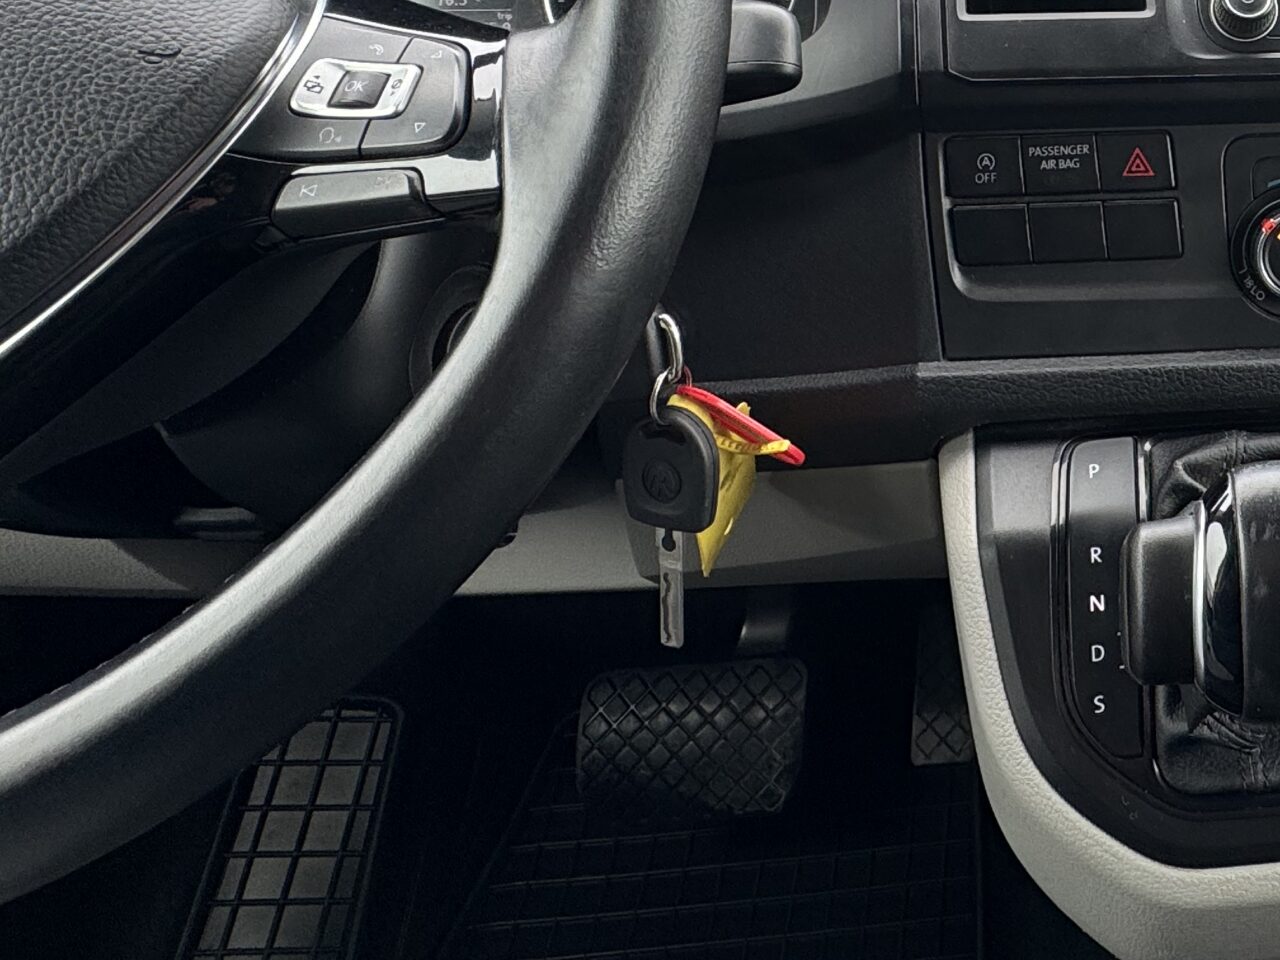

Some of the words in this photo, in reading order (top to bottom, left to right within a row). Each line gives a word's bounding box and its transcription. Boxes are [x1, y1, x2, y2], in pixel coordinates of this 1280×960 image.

[345, 80, 369, 92] OK
[1028, 144, 1090, 157] PASSENGER
[1040, 160, 1057, 170] AIR
[1059, 158, 1080, 169] BAG
[975, 172, 997, 184] OFF
[1088, 464, 1100, 479] P
[1090, 547, 1102, 563] R
[1090, 594, 1105, 612] N
[1091, 645, 1105, 662] D
[1093, 695, 1105, 714] S
